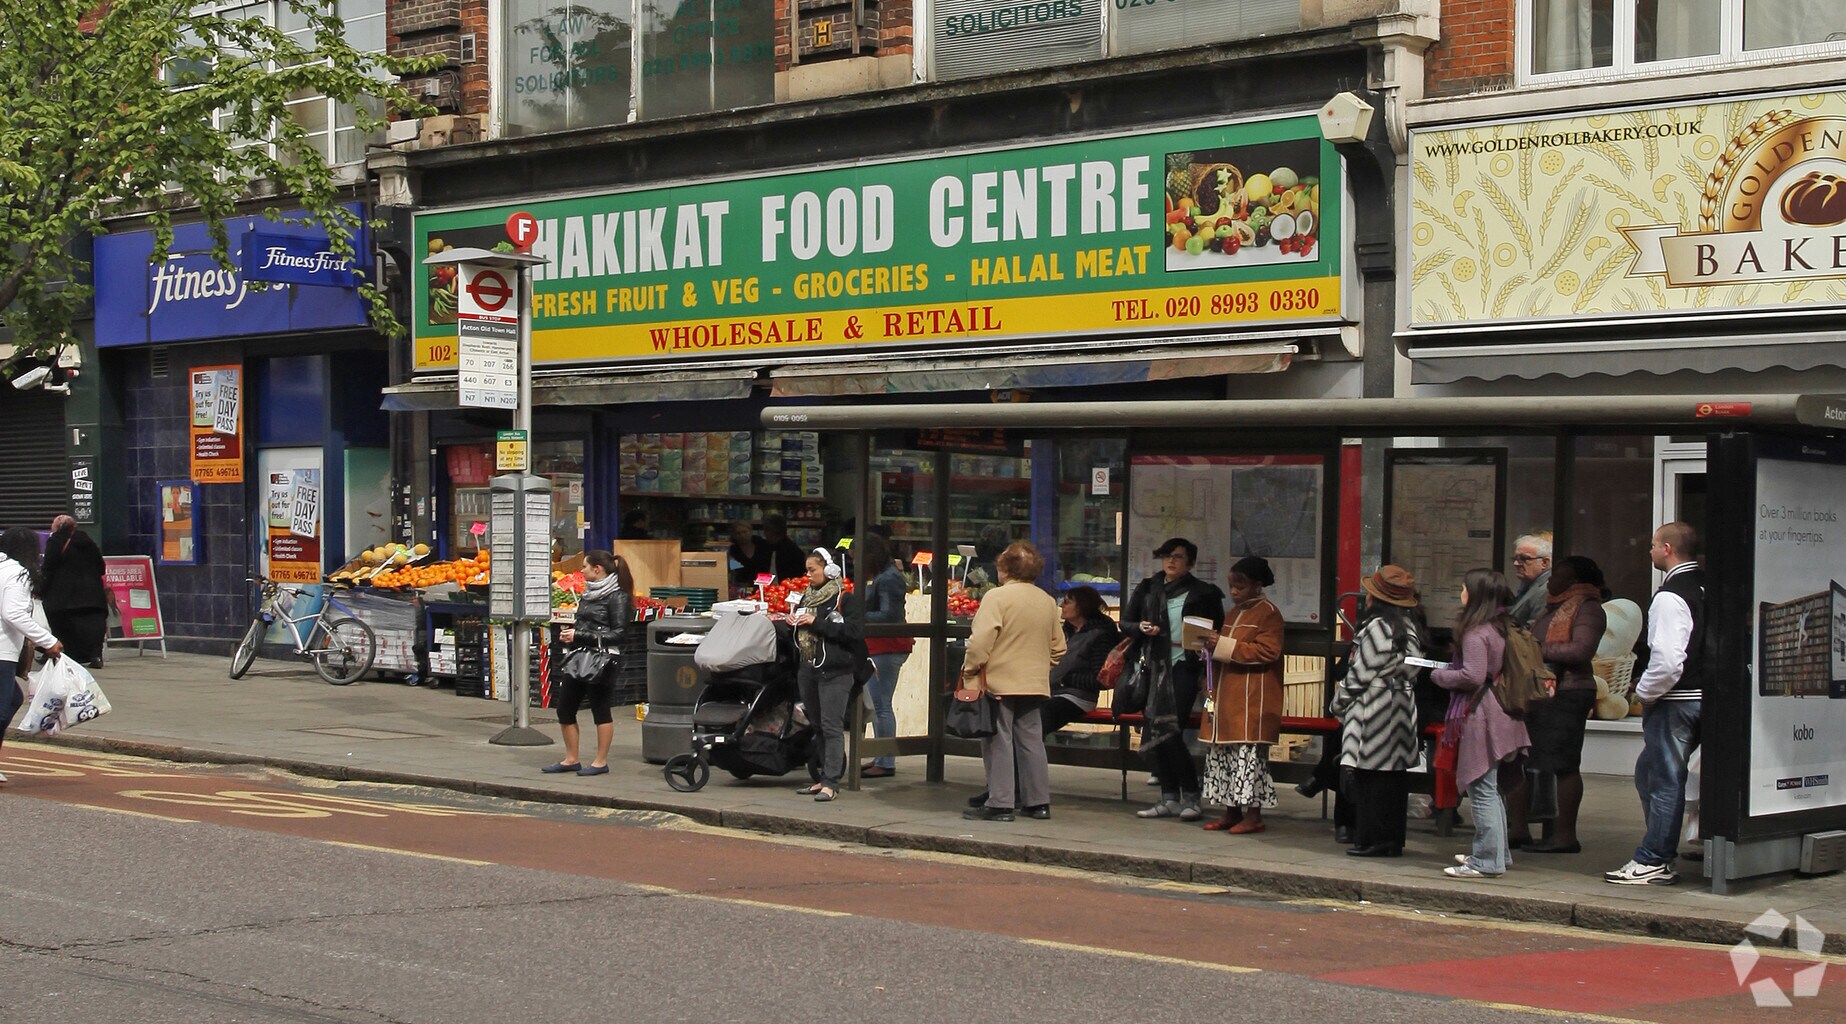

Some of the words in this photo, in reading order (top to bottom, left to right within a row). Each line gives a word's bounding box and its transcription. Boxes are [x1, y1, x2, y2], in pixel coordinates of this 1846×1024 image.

[1425, 121, 1702, 158] WWW.GOLDENROLLBAKERY.CO.UK
[1732, 130, 1843, 221] GOLDEN
[532, 200, 729, 281] HAKIKAT
[762, 184, 894, 262] FOOD
[929, 156, 1150, 248] CENTRE
[518, 218, 532, 241] F
[532, 290, 596, 318] FRESH
[607, 284, 668, 312] FRUIT
[682, 282, 697, 307] &
[712, 277, 759, 304] VEG
[794, 263, 929, 299] GROCERIES
[971, 253, 1064, 286] HALAL
[1076, 245, 1151, 278] MEAT
[1112, 299, 1159, 321] TEL.
[1165, 296, 1201, 317] 020
[1210, 292, 1259, 315] 8993
[1269, 288, 1319, 311] 0330
[462, 324, 480, 332] Acton
[650, 318, 823, 351] WHOLESALE
[844, 315, 864, 340] &
[883, 306, 1001, 337] RETAIL
[429, 345, 451, 362] 102
[483, 360, 495, 368] 207
[463, 376, 477, 384] 440
[195, 389, 203, 400] Try
[220, 384, 238, 401] FREE
[205, 400, 213, 408] for
[218, 399, 236, 418] DAY
[195, 411, 207, 419] free!
[216, 416, 234, 432] PASS
[195, 468, 213, 477] 07765
[216, 467, 239, 477] 496711
[271, 490, 280, 500] Try
[297, 486, 317, 503] FREE
[271, 501, 280, 509] out
[281, 500, 290, 509] for
[295, 501, 315, 520] DAY
[271, 511, 284, 520] free!
[1760, 504, 1779, 519] Over
[1781, 506, 1786, 520] 3
[1814, 507, 1837, 523] books
[293, 517, 313, 535] PASS
[1759, 529, 1767, 541] at
[1769, 530, 1785, 544] your
[1788, 527, 1824, 546] fingertips.
[106, 574, 143, 582] AVAILABLE
[271, 570, 290, 580] 07765
[293, 570, 317, 580] 496711
[1793, 724, 1814, 741] kobo
